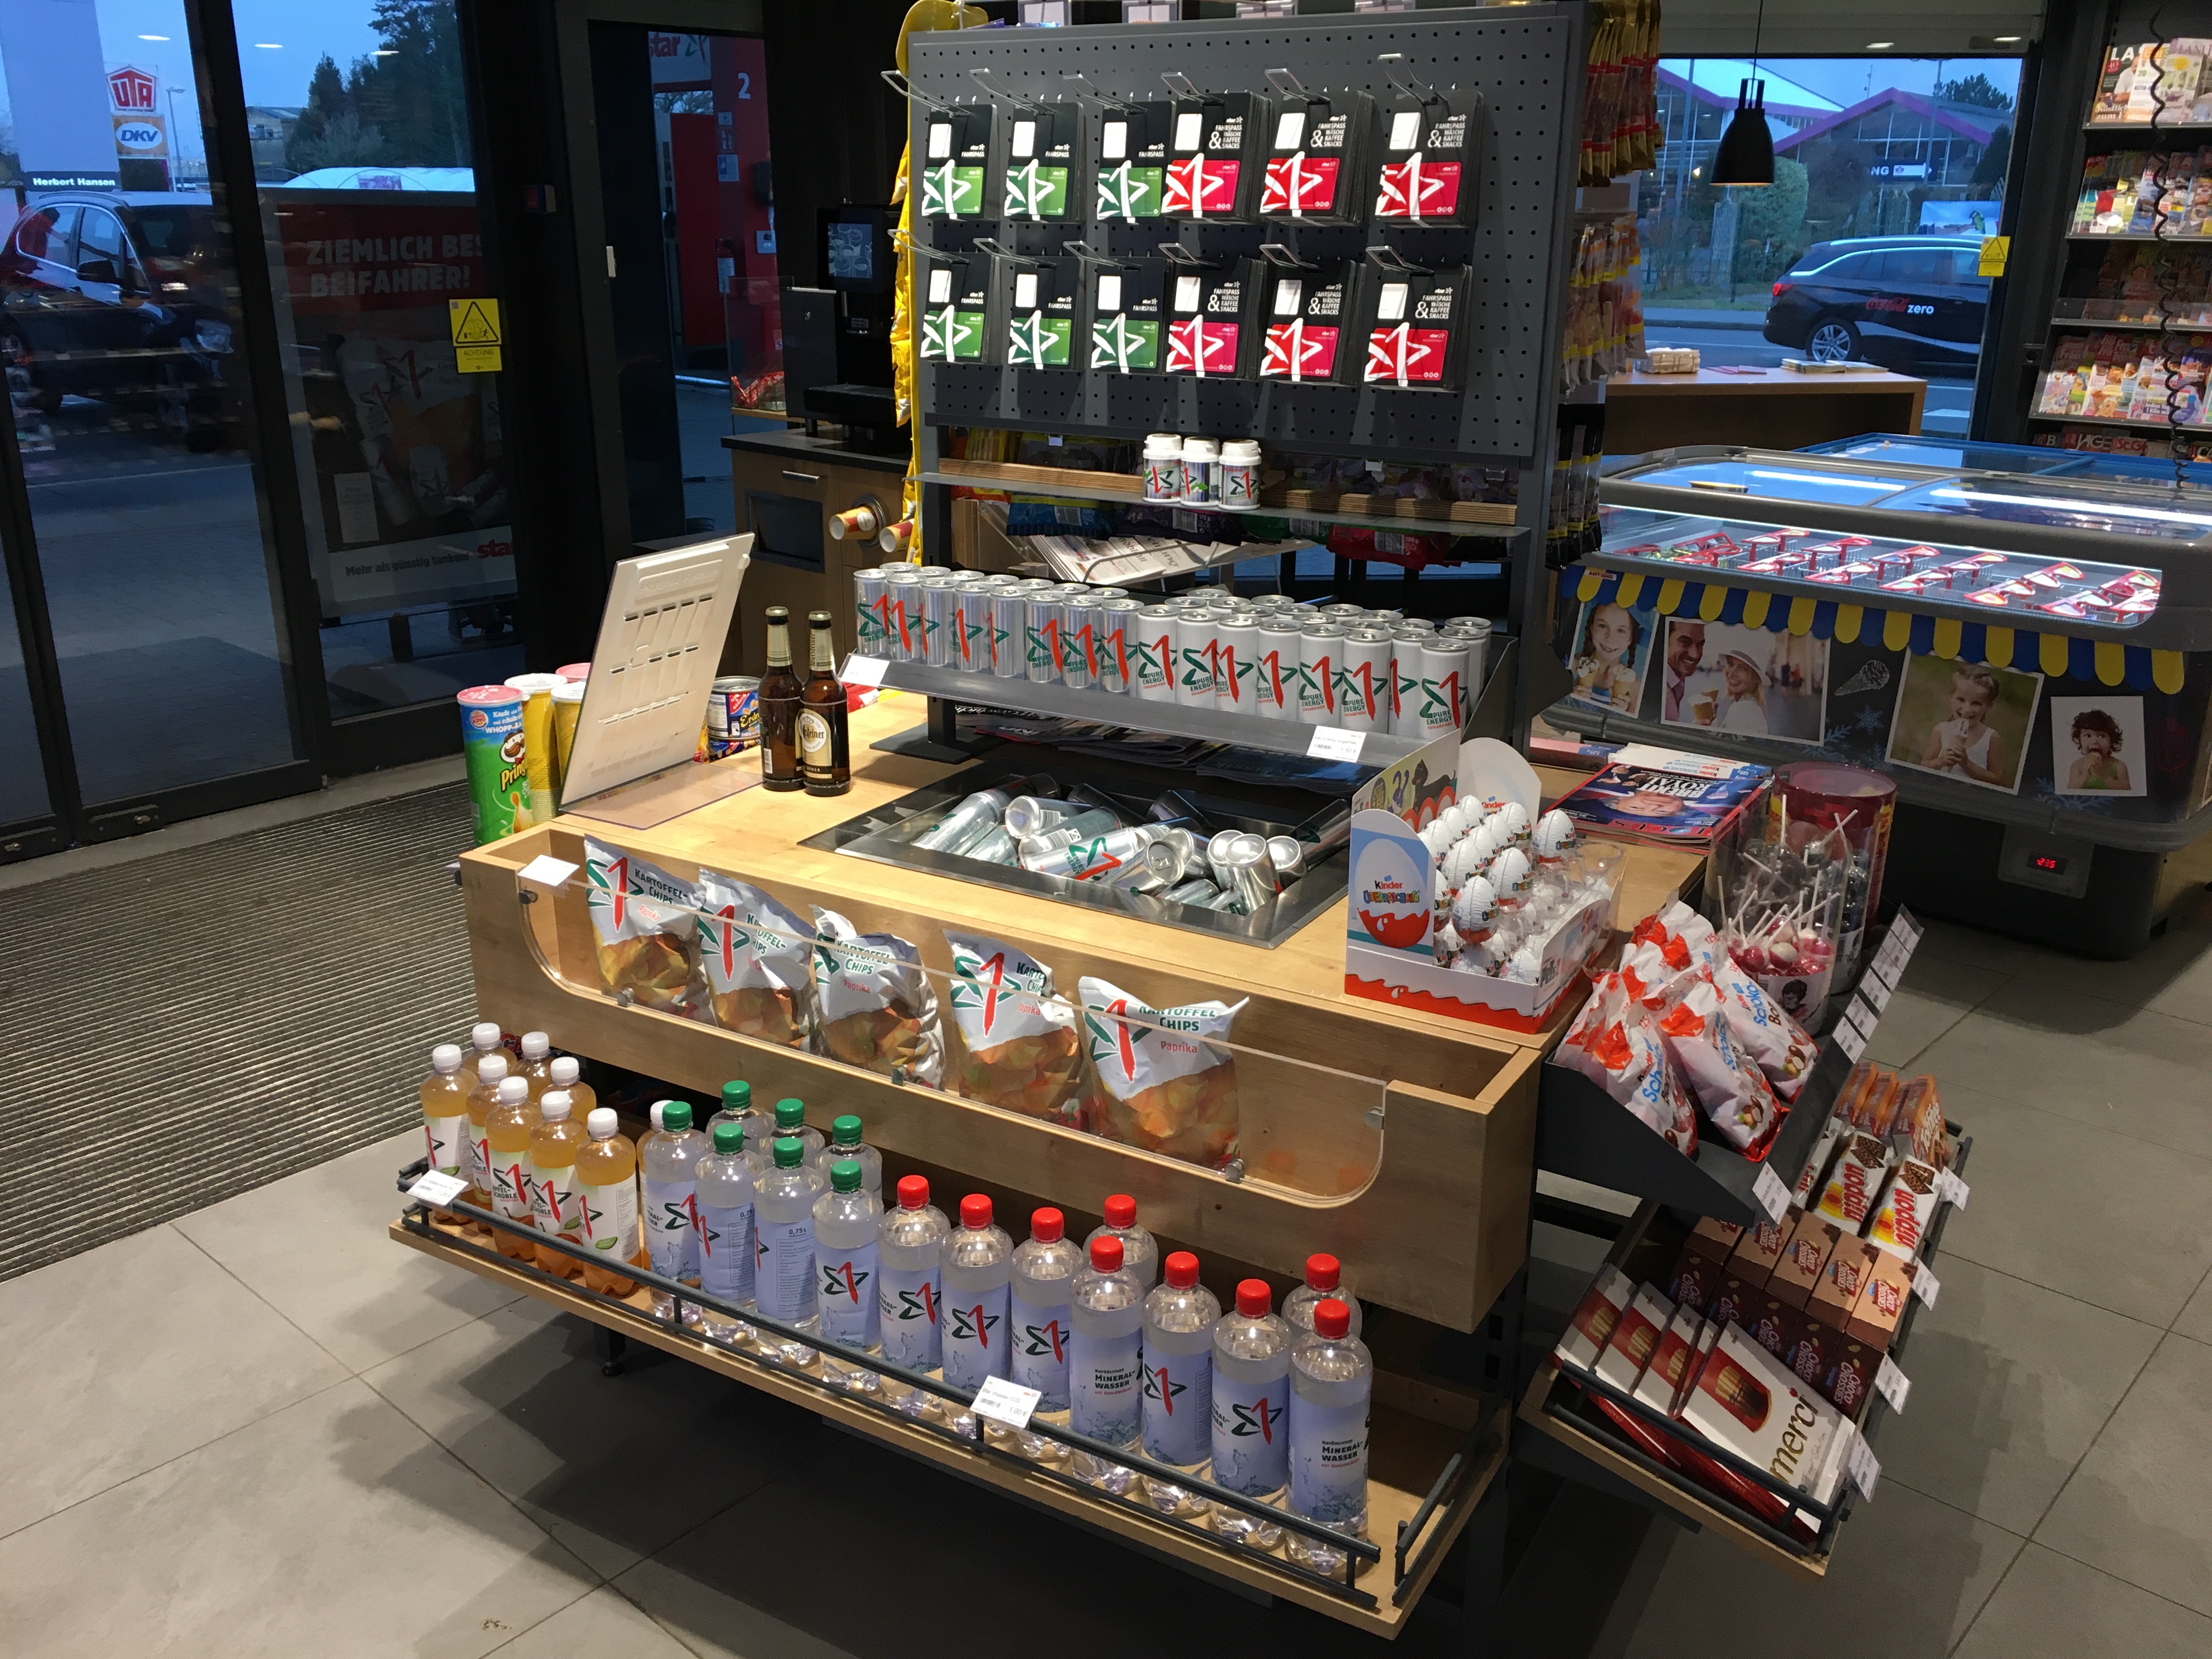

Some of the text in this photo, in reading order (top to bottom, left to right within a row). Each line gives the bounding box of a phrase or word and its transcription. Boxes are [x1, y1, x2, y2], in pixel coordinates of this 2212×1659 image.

[110, 70, 154, 108] UTA
[738, 72, 751, 100] 2
[121, 129, 158, 142] DKV
[1209, 131, 1222, 149] &
[1311, 129, 1323, 148] &
[1427, 129, 1442, 148] &
[33, 178, 75, 186] Herbert
[307, 235, 432, 265] ZIEMLICH
[311, 266, 470, 298] BEIFAHRER!
[1207, 295, 1220, 312] &
[1308, 297, 1320, 314] &
[1415, 301, 1429, 319] &
[1907, 304, 1934, 315] zero
[1032, 659, 1054, 668] ENERGY
[1142, 675, 1165, 685] ENERGY
[1190, 680, 1214, 692] ENERGY
[1197, 675, 1213, 685] PURE
[1302, 698, 1324, 707] ENERGY
[1427, 714, 1453, 725] ENERGY
[1433, 708, 1452, 719] PURE
[1638, 783, 1703, 798] BREXIT
[1647, 776, 1712, 792] ROYAL
[634, 868, 689, 900] KARTOFFEL-
[1374, 879, 1403, 891] Kinder
[648, 885, 674, 905] CHIPS
[637, 904, 661, 922] Paprika
[845, 957, 873, 975] CHIPS
[843, 978, 871, 995] Paprika
[1159, 1017, 1200, 1032] CHIPS
[1160, 1040, 1198, 1054] Paprika
[1841, 1162, 1868, 1224] nippon
[1894, 1188, 1921, 1251] nippon
[1094, 1370, 1136, 1381] MINERAL-
[1094, 1380, 1130, 1389] WASSER
[1847, 1373, 1860, 1405] CHOCO
[992, 1391, 1009, 1401] Wasser
[1009, 1396, 1021, 1404] CO2
[1009, 1407, 1028, 1418] 1.00 €
[1769, 1394, 1820, 1482] merci
[1322, 1441, 1363, 1454] MINERAL-
[1322, 1451, 1358, 1462] WASSER
